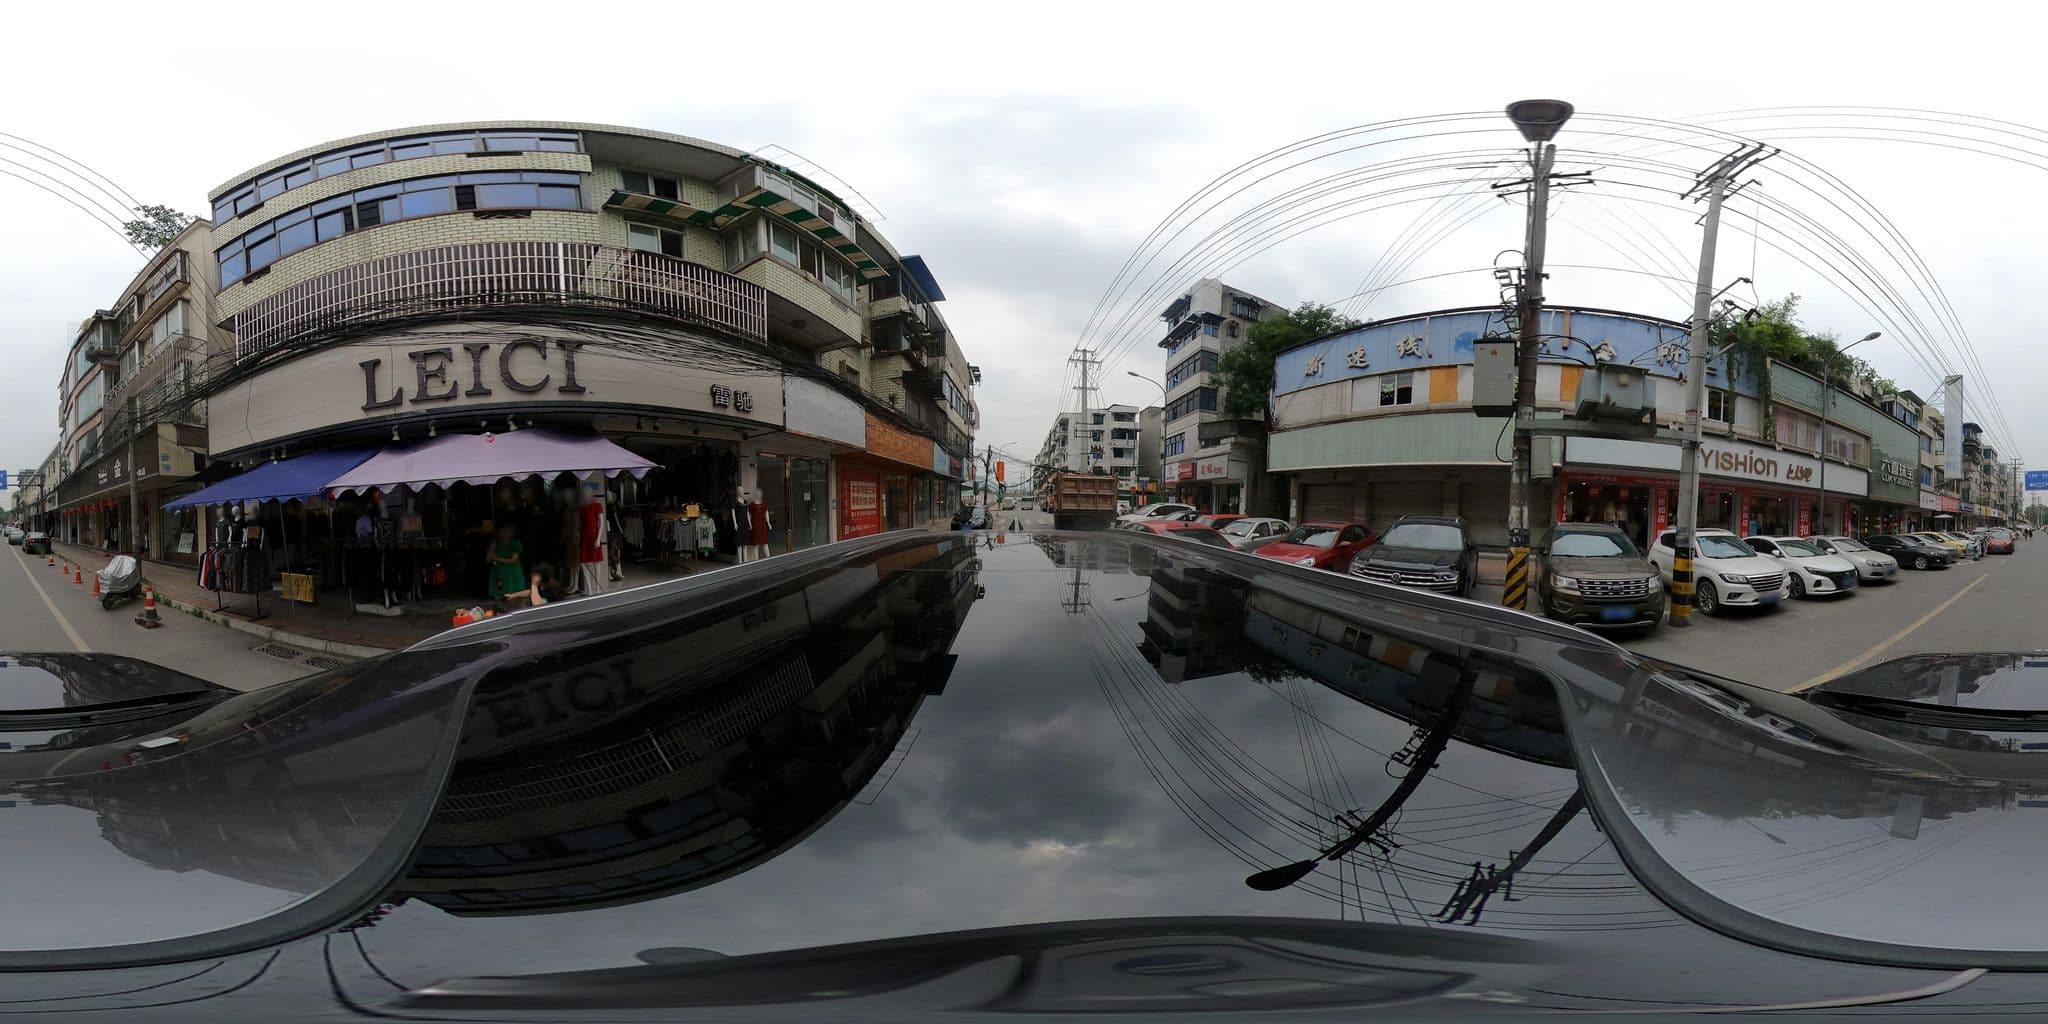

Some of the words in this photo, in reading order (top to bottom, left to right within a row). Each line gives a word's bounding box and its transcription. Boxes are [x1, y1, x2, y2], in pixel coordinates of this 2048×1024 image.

[359, 338, 587, 412] LEICI
[1304, 335, 1424, 379] 新速线
[710, 384, 753, 414] 雷驰
